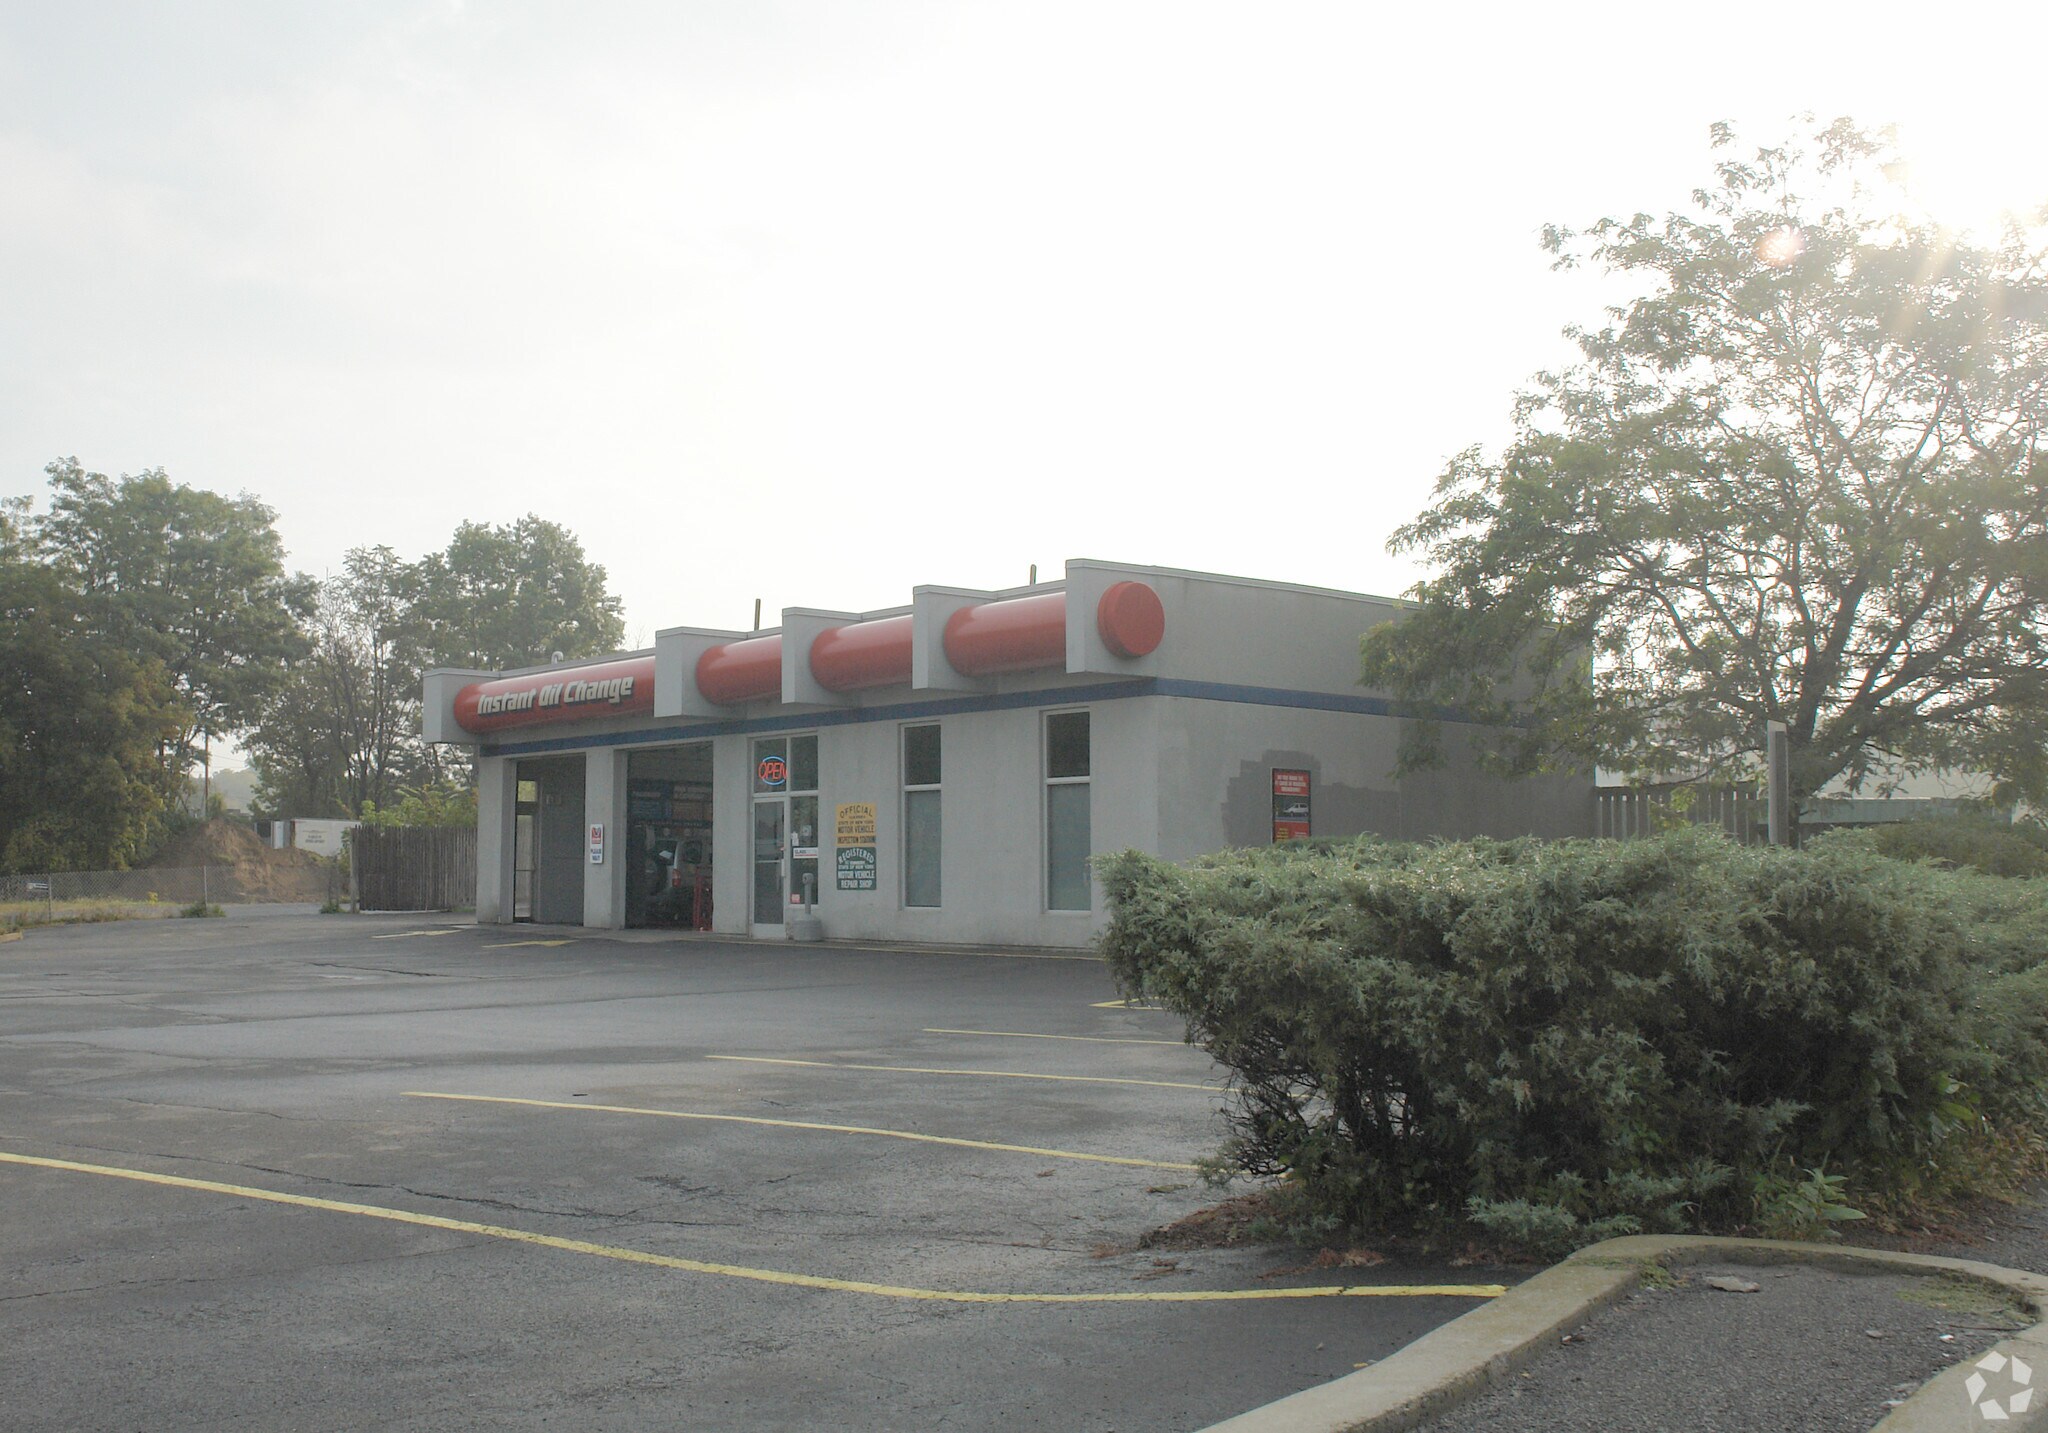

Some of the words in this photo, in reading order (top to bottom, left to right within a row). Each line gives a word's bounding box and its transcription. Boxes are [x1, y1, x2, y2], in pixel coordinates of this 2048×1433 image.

[478, 689, 537, 714] Instant
[538, 684, 564, 706] Oil
[564, 676, 634, 703] Change
[758, 762, 788, 780] OPEN
[840, 805, 873, 818] OFFICIAL
[855, 825, 874, 833] VEHICLE
[838, 849, 874, 864] REGISTERED
[855, 870, 875, 879] VEHICLE
[841, 880, 858, 888] REPAIR
[859, 880, 873, 888] SHOP
